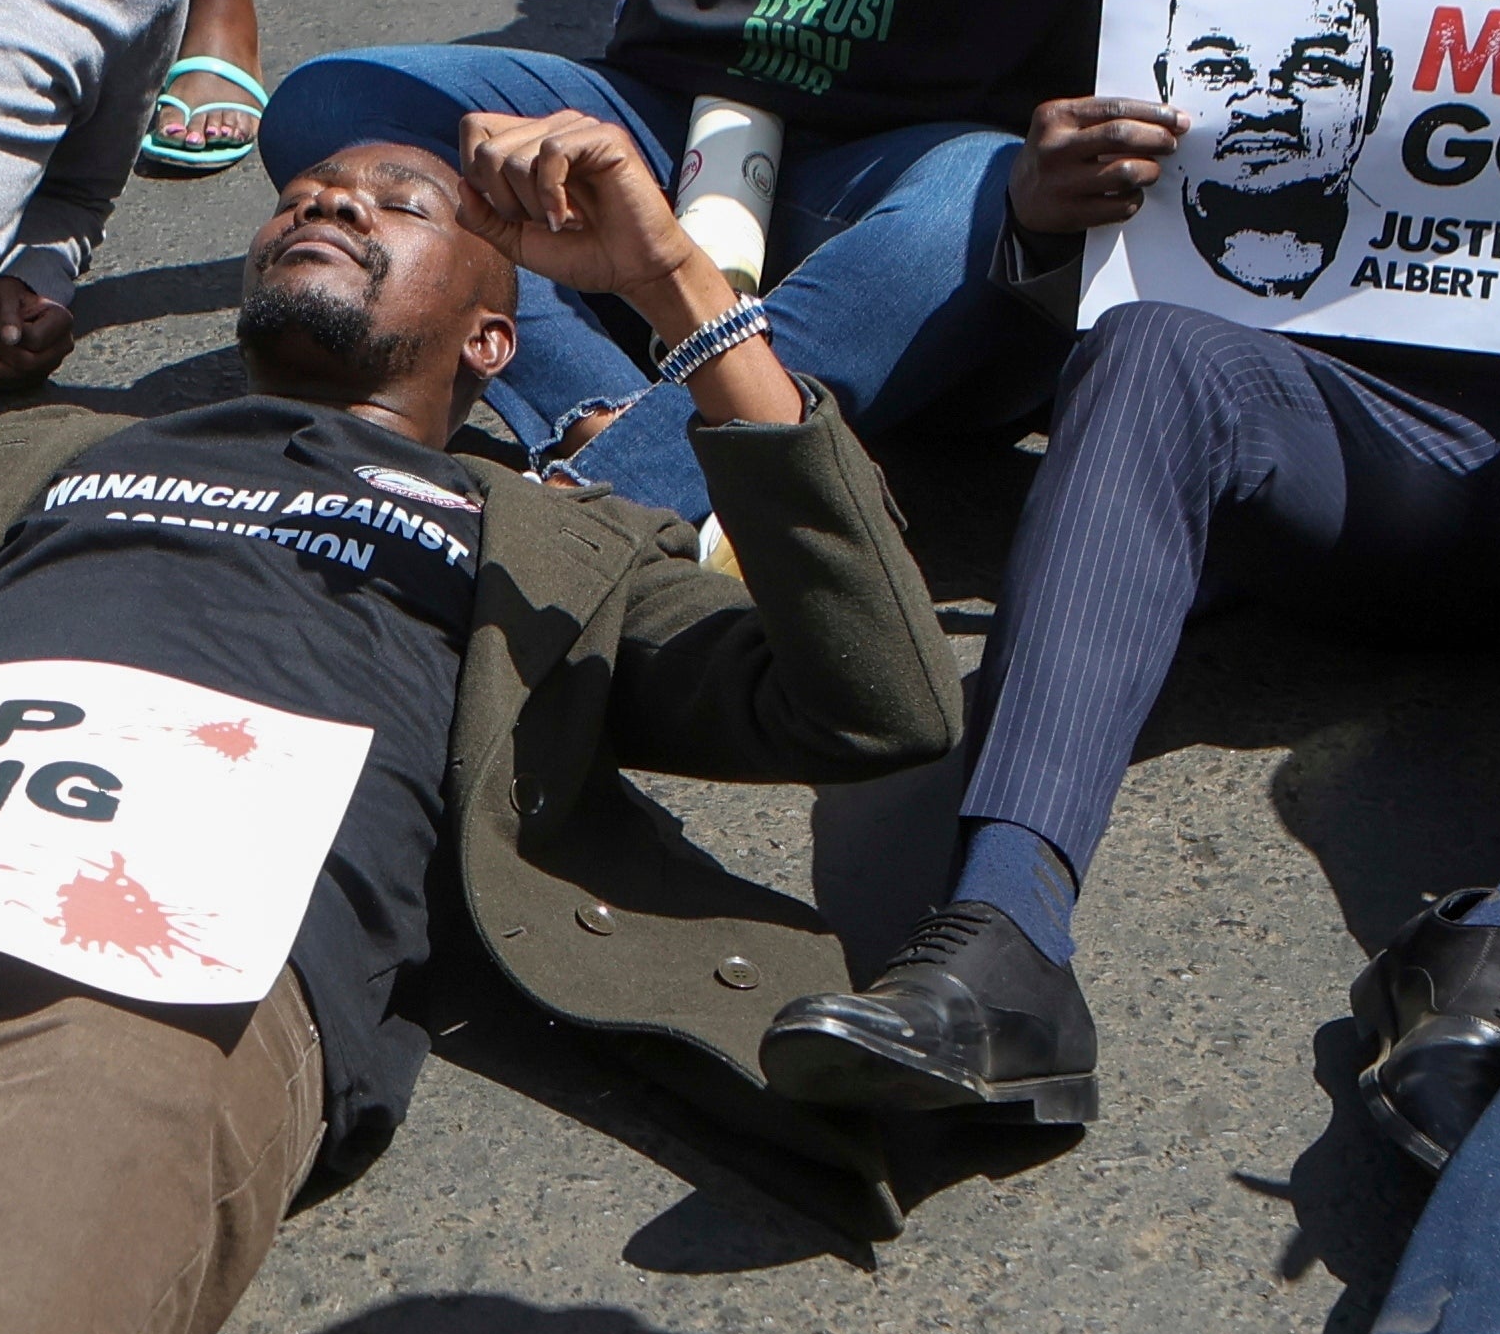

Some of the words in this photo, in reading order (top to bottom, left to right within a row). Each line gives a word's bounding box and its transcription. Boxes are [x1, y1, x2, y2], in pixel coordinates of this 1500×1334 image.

[1350, 255, 1498, 302] ALBERT
[43, 473, 280, 512] WANAINCHI
[284, 491, 470, 568] AGAINST
